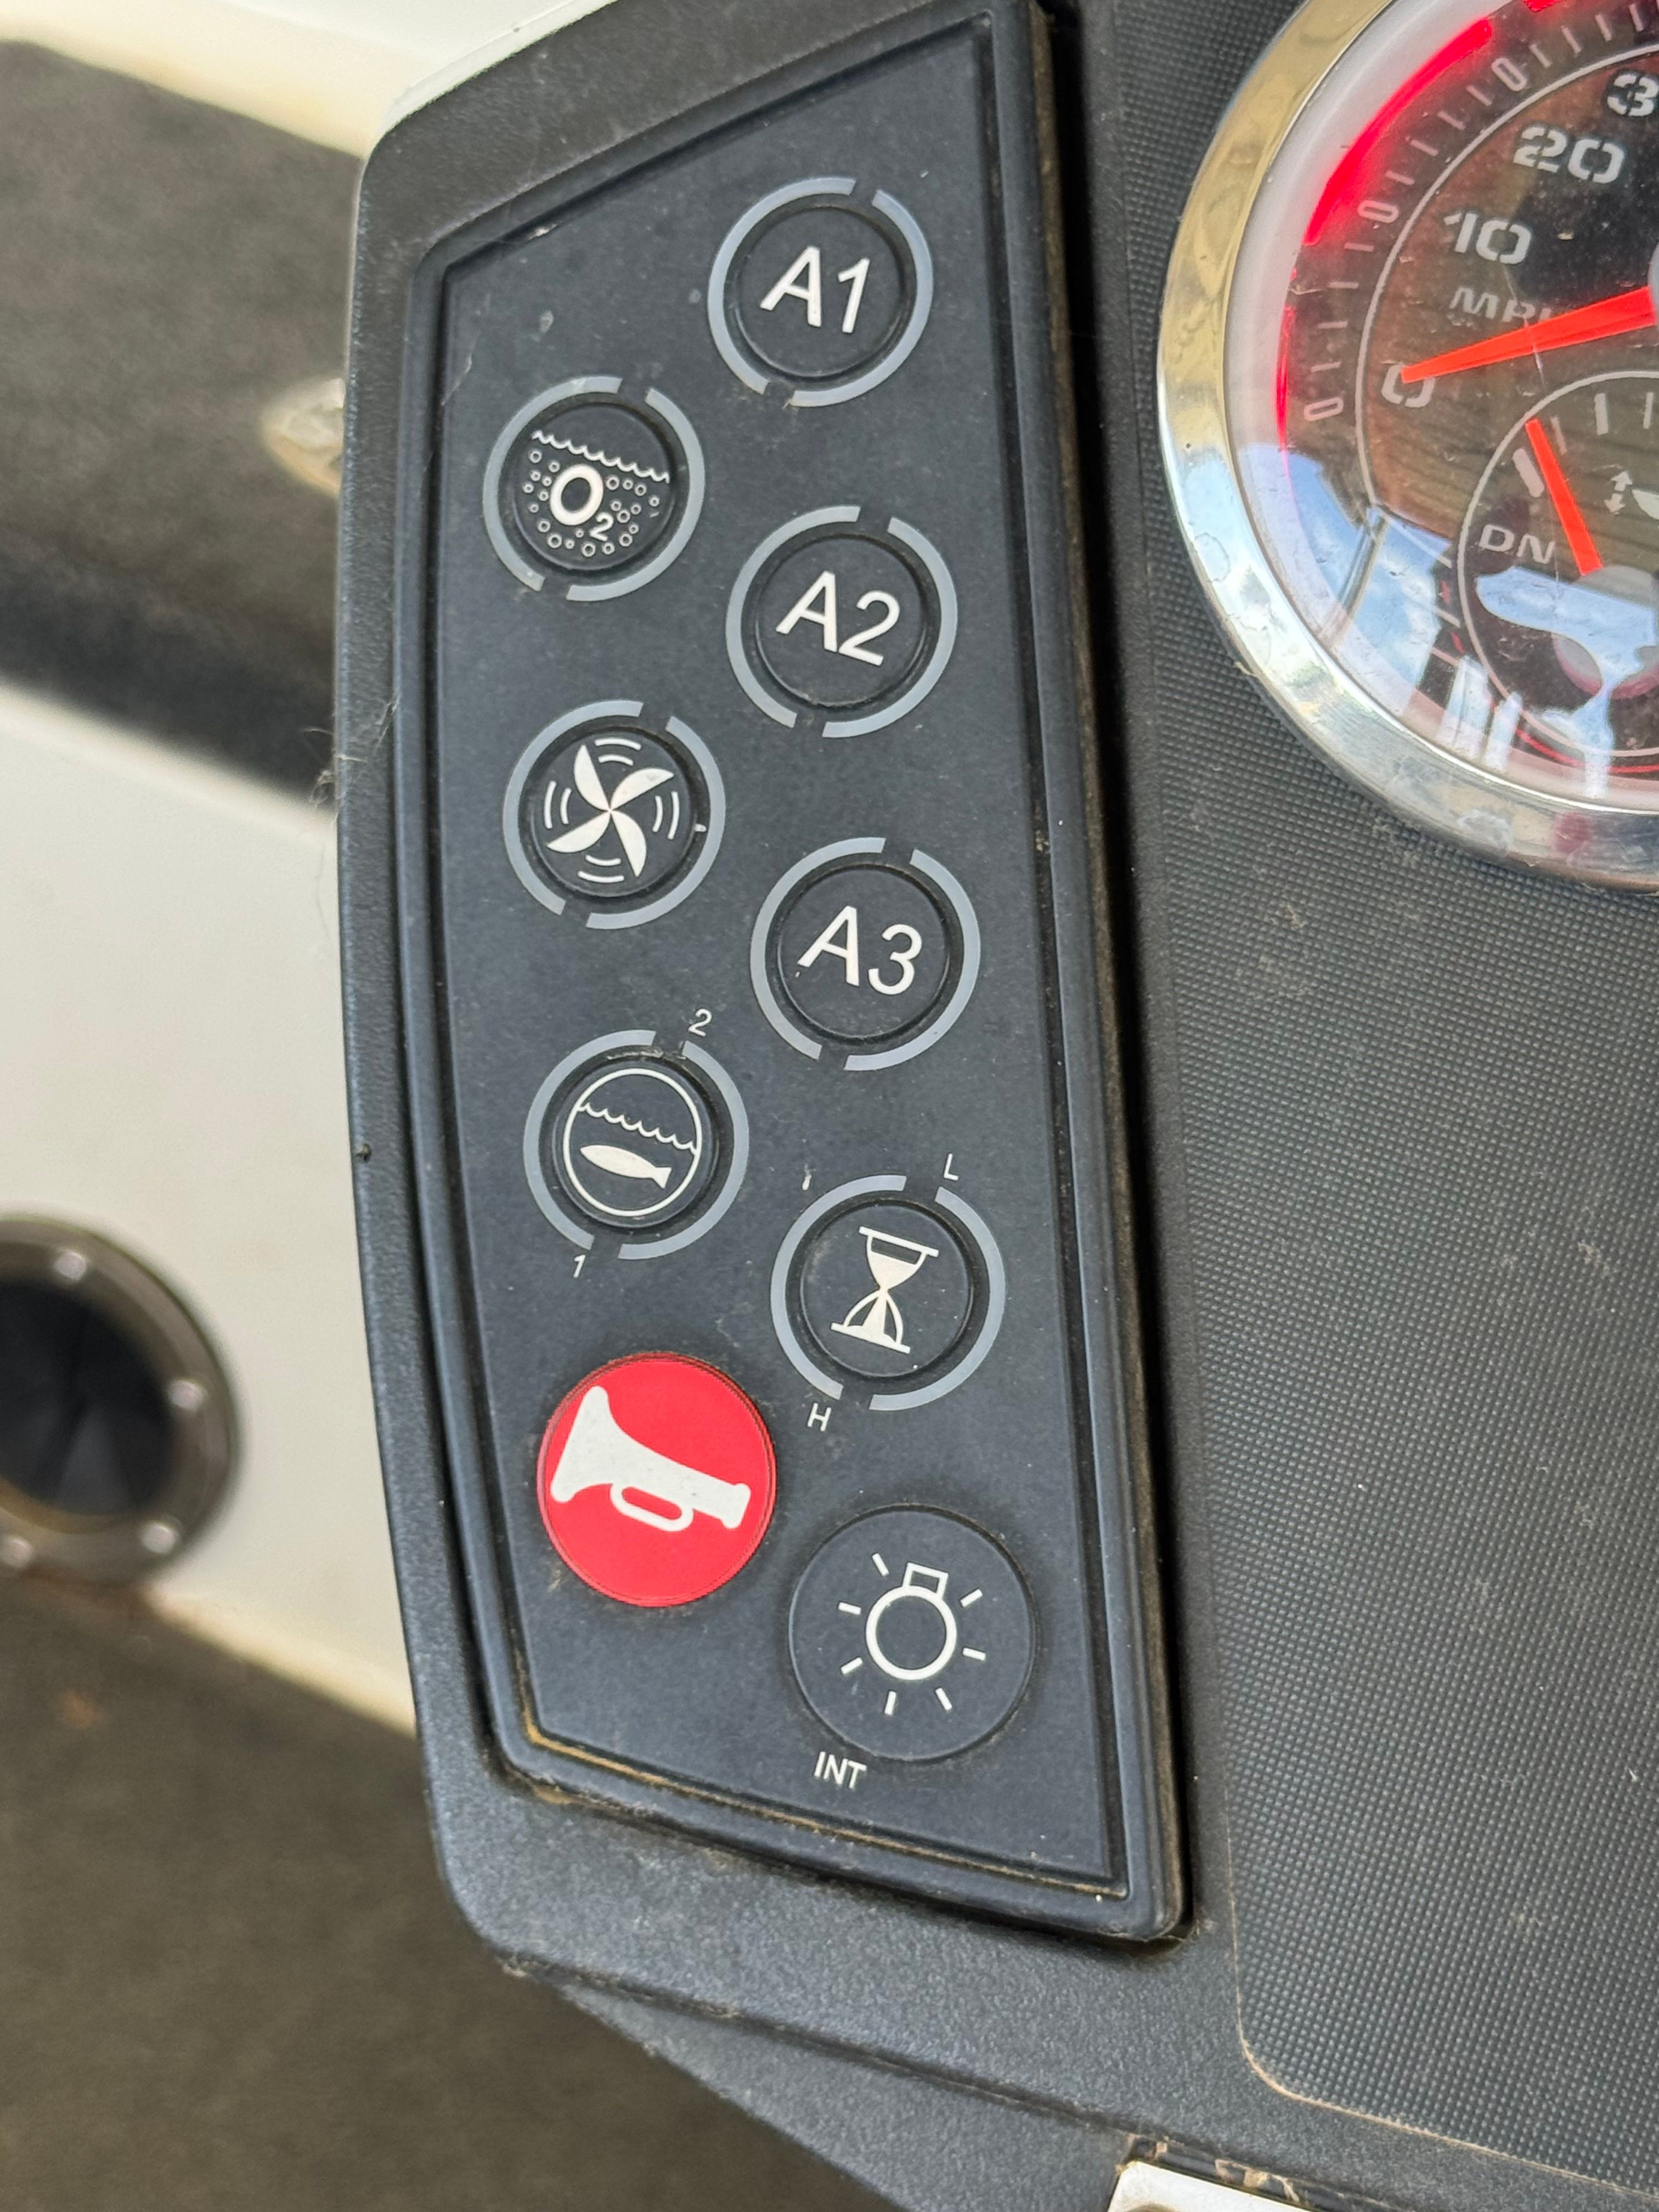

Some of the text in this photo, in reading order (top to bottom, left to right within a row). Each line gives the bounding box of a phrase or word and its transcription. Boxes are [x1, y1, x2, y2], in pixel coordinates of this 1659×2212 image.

[1514, 127, 1625, 184] 20
[1443, 212, 1532, 264] 10
[760, 246, 870, 333] A1
[1381, 362, 1436, 408] 0
[1479, 524, 1555, 564] DN
[776, 571, 900, 666] A2
[798, 906, 922, 995] A3
[688, 1008, 712, 1037] 2
[943, 1153, 960, 1182] L
[573, 1254, 586, 1278] 1
[807, 1402, 832, 1432] H
[814, 1751, 867, 1790] INT
